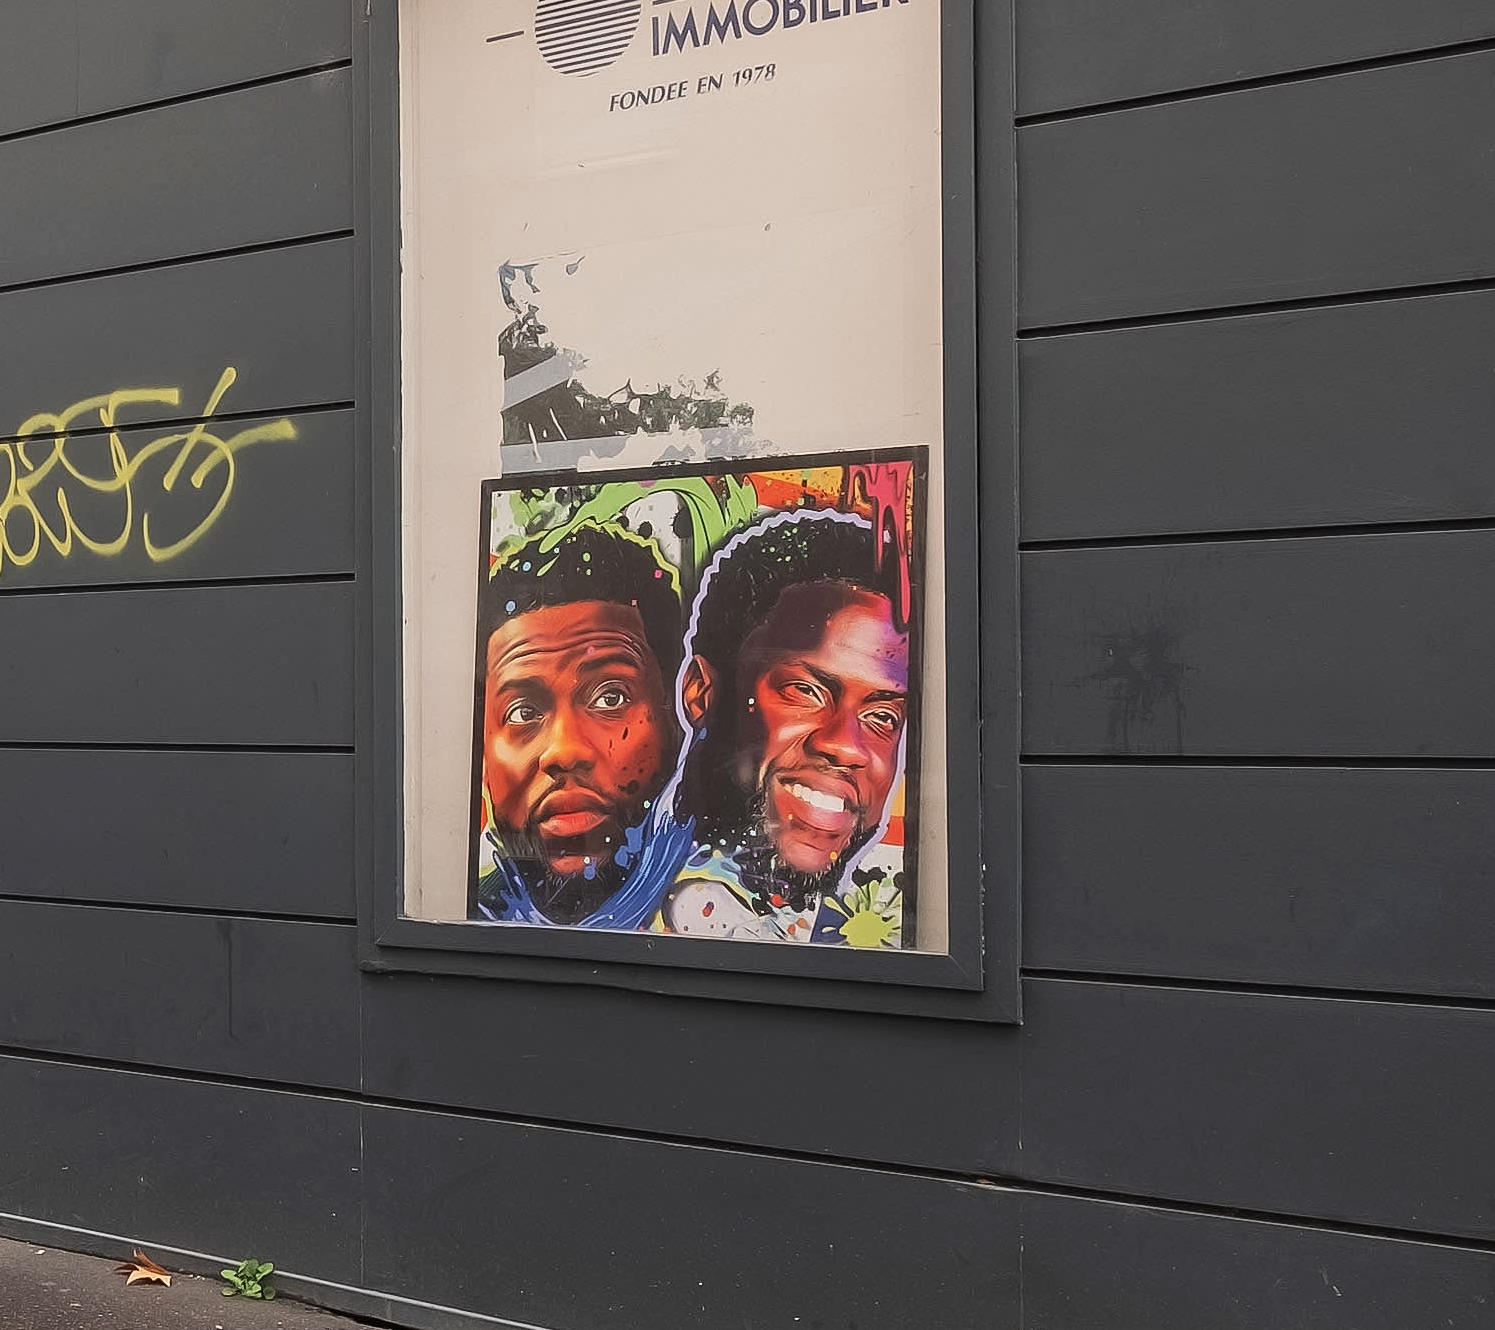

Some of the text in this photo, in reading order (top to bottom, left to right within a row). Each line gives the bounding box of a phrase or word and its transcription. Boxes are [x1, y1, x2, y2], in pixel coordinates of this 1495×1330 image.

[608, 63, 777, 113] FONDEE EN 1978
